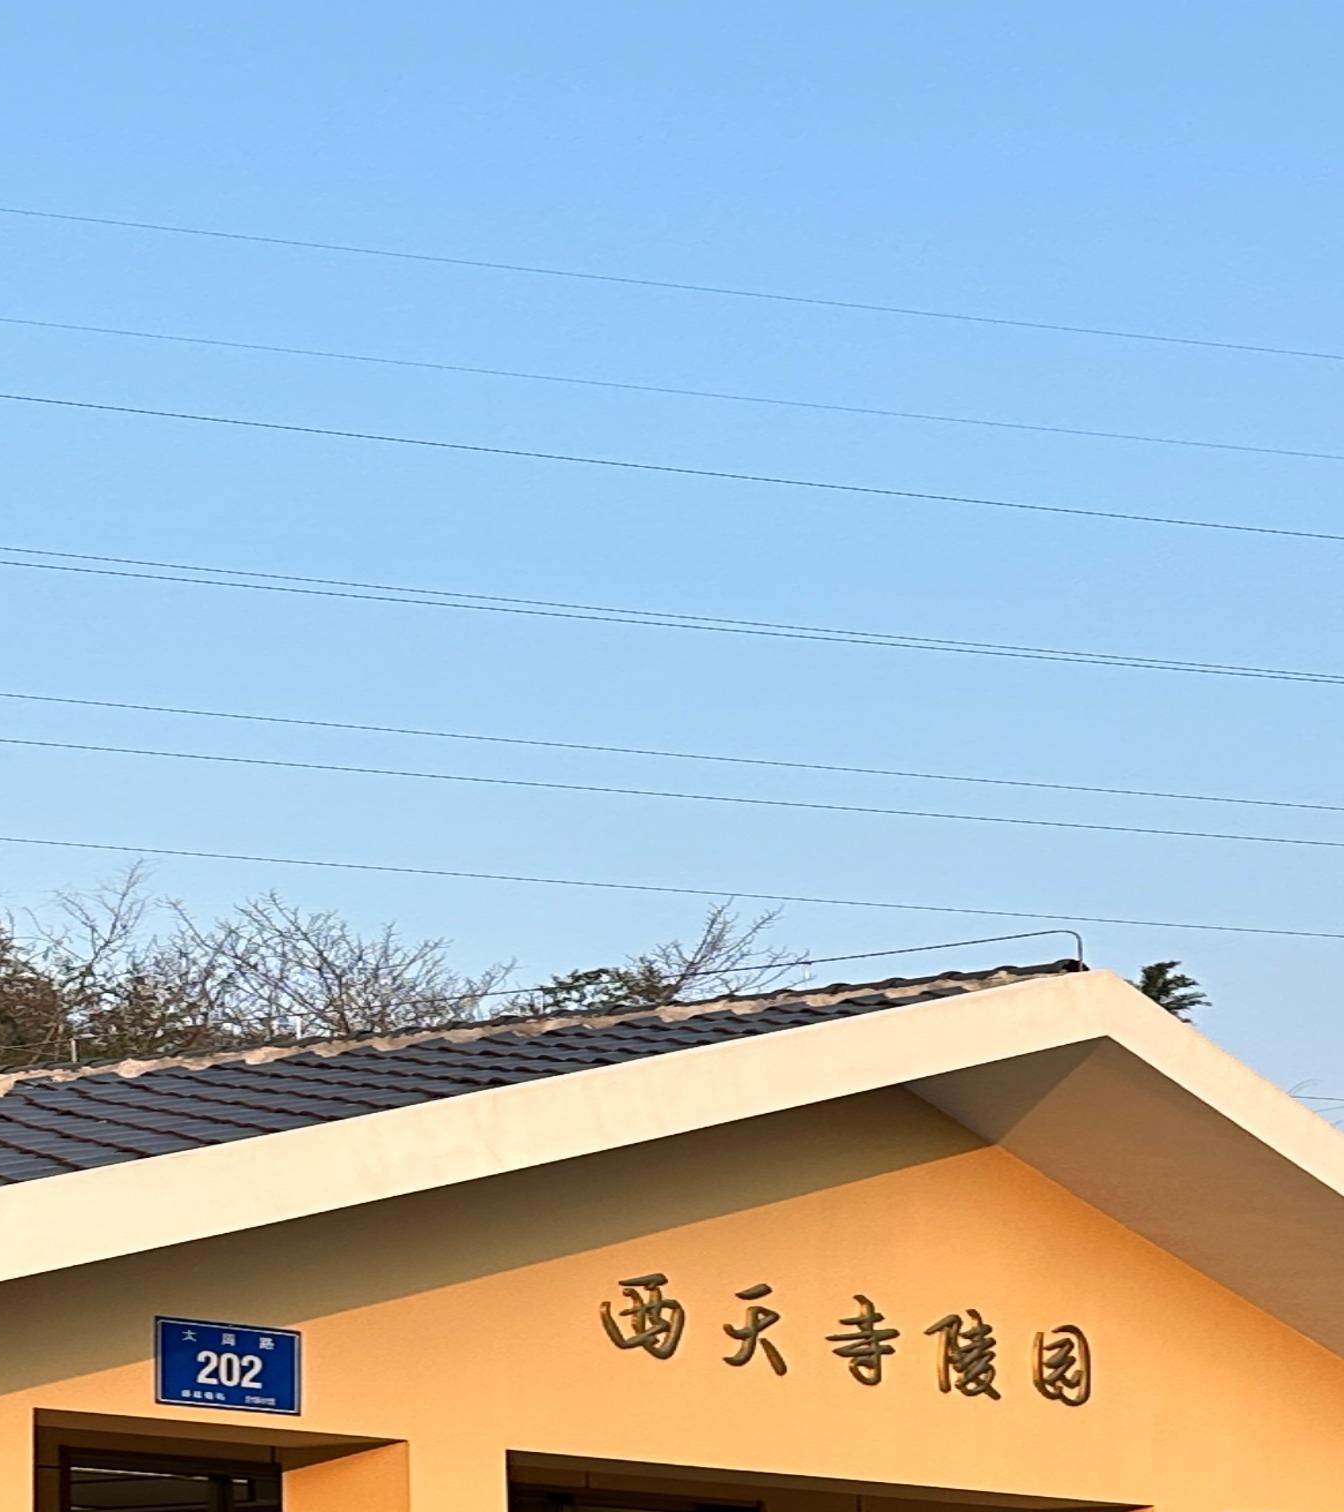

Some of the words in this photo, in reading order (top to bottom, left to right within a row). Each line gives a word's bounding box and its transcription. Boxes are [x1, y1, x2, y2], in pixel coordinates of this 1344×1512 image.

[196, 1350, 263, 1389] 202
[599, 1272, 1092, 1407] 西天寺陵园
